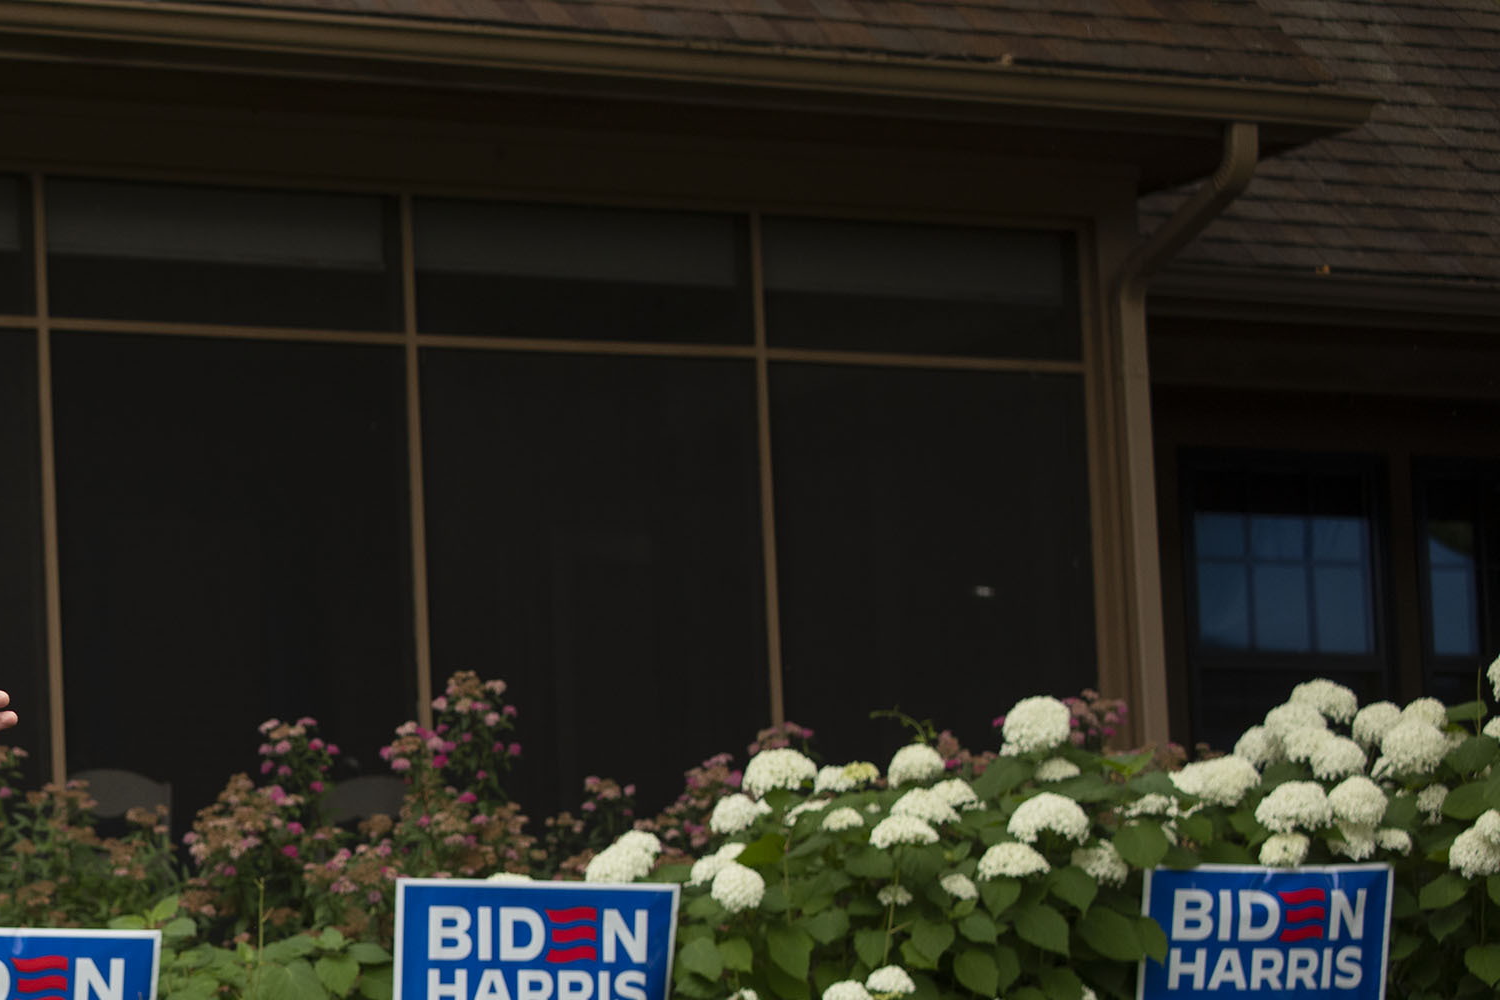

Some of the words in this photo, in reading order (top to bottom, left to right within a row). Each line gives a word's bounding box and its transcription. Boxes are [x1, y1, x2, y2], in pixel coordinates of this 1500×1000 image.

[428, 906, 648, 964] BIDEN
[1172, 888, 1365, 941] BIDEN
[1168, 948, 1362, 990] HARRIS
